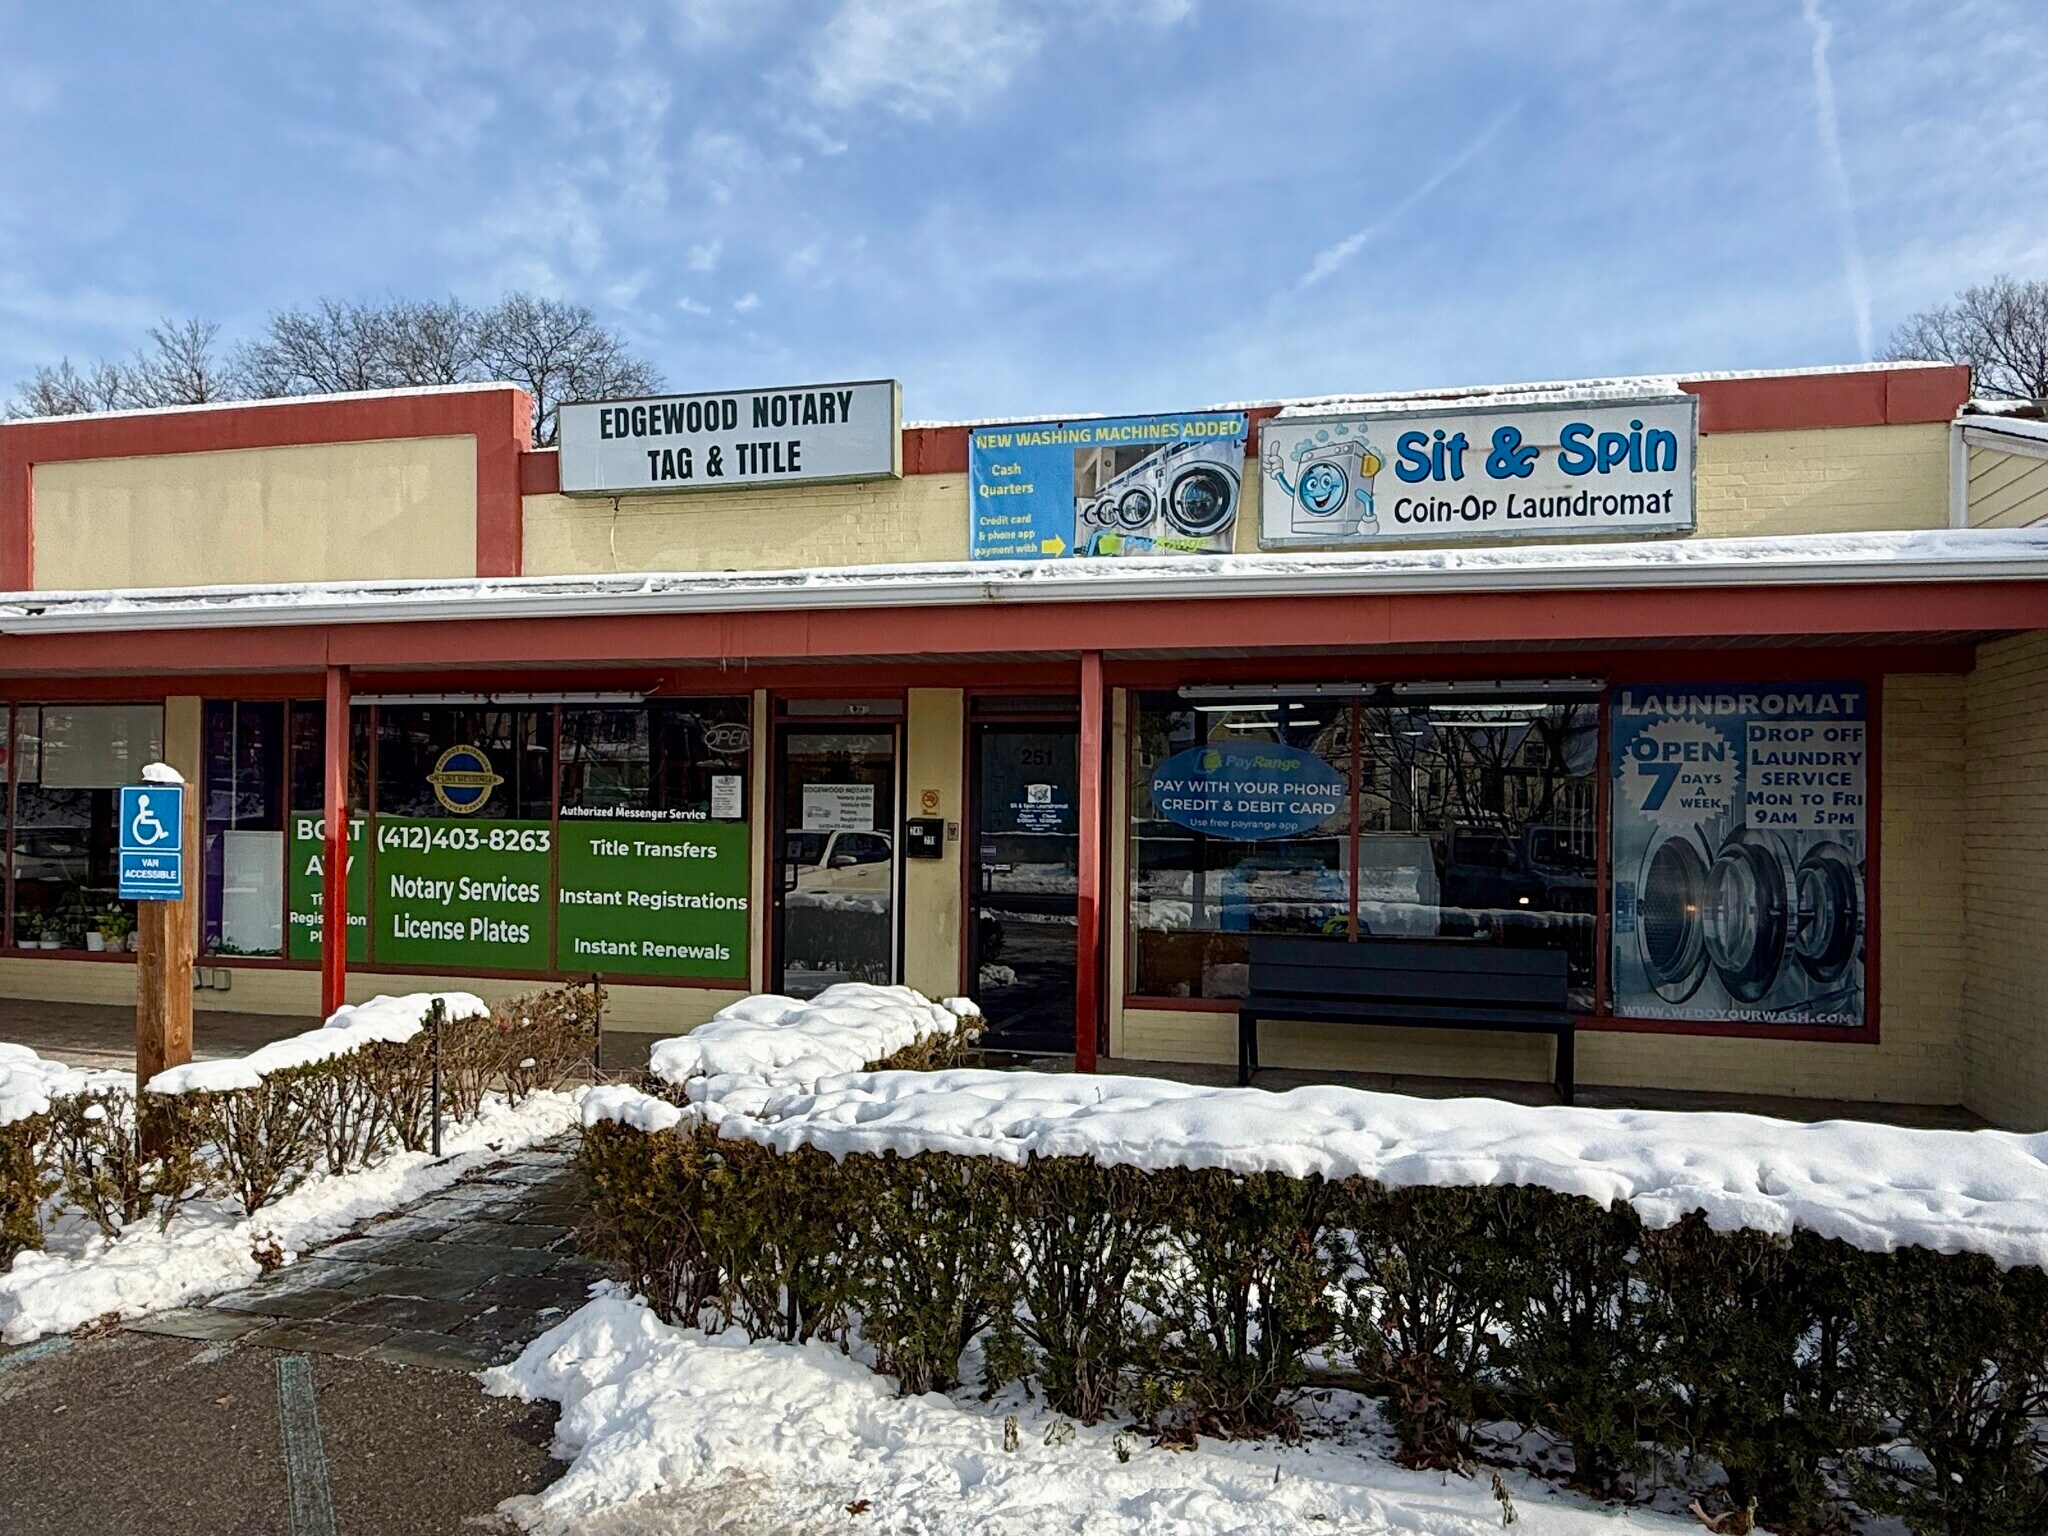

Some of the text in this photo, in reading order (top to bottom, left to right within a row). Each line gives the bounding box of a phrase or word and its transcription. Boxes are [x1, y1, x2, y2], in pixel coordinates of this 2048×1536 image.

[600, 391, 853, 440] EDGEWOOD NOTARY
[976, 420, 1242, 449] NEW WASHING MACHINES ADDED
[1395, 419, 1677, 483] Sit & Spin
[648, 441, 801, 481] TAG & TITLE
[991, 464, 1021, 476] Cash
[979, 482, 1034, 498] Quarters
[1394, 489, 1673, 524] Coin-Op Laundromat
[979, 513, 1032, 526] Credit card
[978, 529, 1036, 543] & phone app
[974, 542, 1038, 558] payment with
[1621, 691, 1859, 716] LAUNDROMAT
[704, 730, 750, 747] OPEN
[1748, 725, 1863, 742] DROP OFF
[1021, 749, 1052, 765] 251
[1631, 737, 1726, 762] OPEN
[1225, 754, 1301, 771] PayRange
[1751, 751, 1863, 766] LAUNDRY
[1638, 762, 1683, 811] 7
[1681, 773, 1722, 785] DAYS
[1761, 771, 1852, 786] SERVICE
[1153, 780, 1342, 797] PAY WITH YOUR PHONE
[1695, 786, 1706, 797] A
[1161, 798, 1336, 815] CREDIT & DEBIT CARD
[1680, 798, 1720, 809] WEEK
[1747, 791, 1863, 807] MON TO FRI
[560, 806, 707, 820] Authorized Messenger Service
[1755, 809, 1854, 824] 9AM 5PM
[1190, 818, 1298, 831] Use free payrange app
[378, 825, 551, 853] (412)403-8263
[590, 840, 718, 859] Title Transfers
[142, 858, 159, 868] VAN
[124, 869, 177, 880] ACCESSIBLE
[390, 874, 540, 905] Notary Services
[560, 888, 748, 911] Instant Registrations
[393, 912, 530, 944] License Plates
[574, 938, 730, 961] Instant Renewals
[1622, 1004, 1856, 1025] WWW.WEDOYOURWASH.COM
